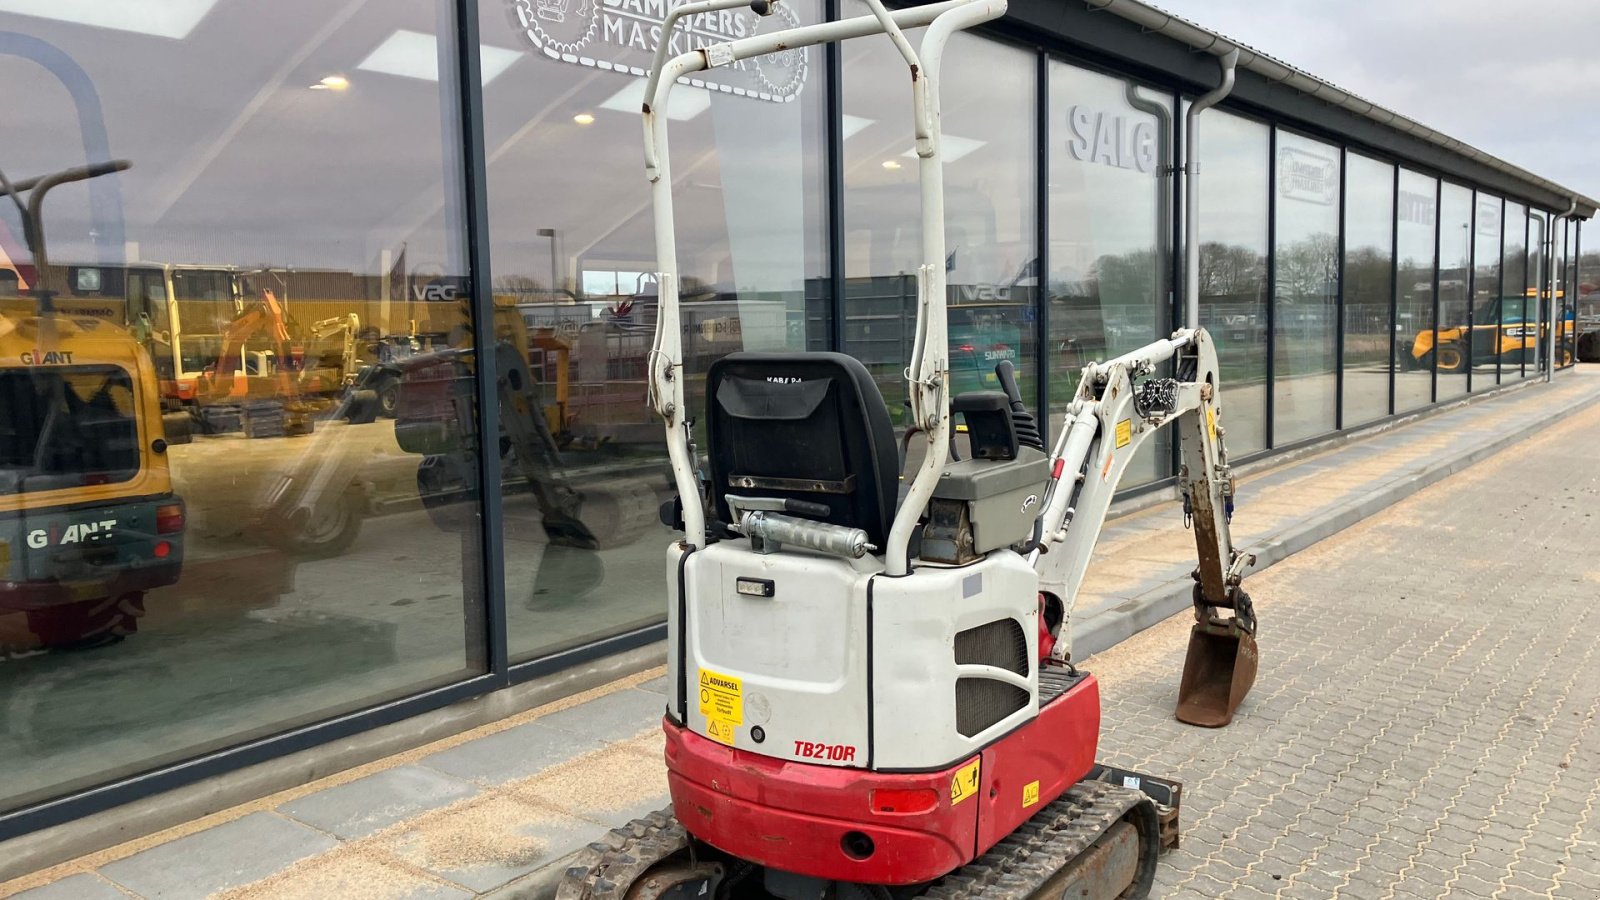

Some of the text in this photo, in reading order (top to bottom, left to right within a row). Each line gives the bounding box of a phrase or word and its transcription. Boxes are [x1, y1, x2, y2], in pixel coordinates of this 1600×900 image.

[1067, 105, 1157, 173] SALG
[20, 349, 73, 365] GIANT
[709, 677, 739, 691] ADVARSEL
[794, 740, 856, 761] TB210R
